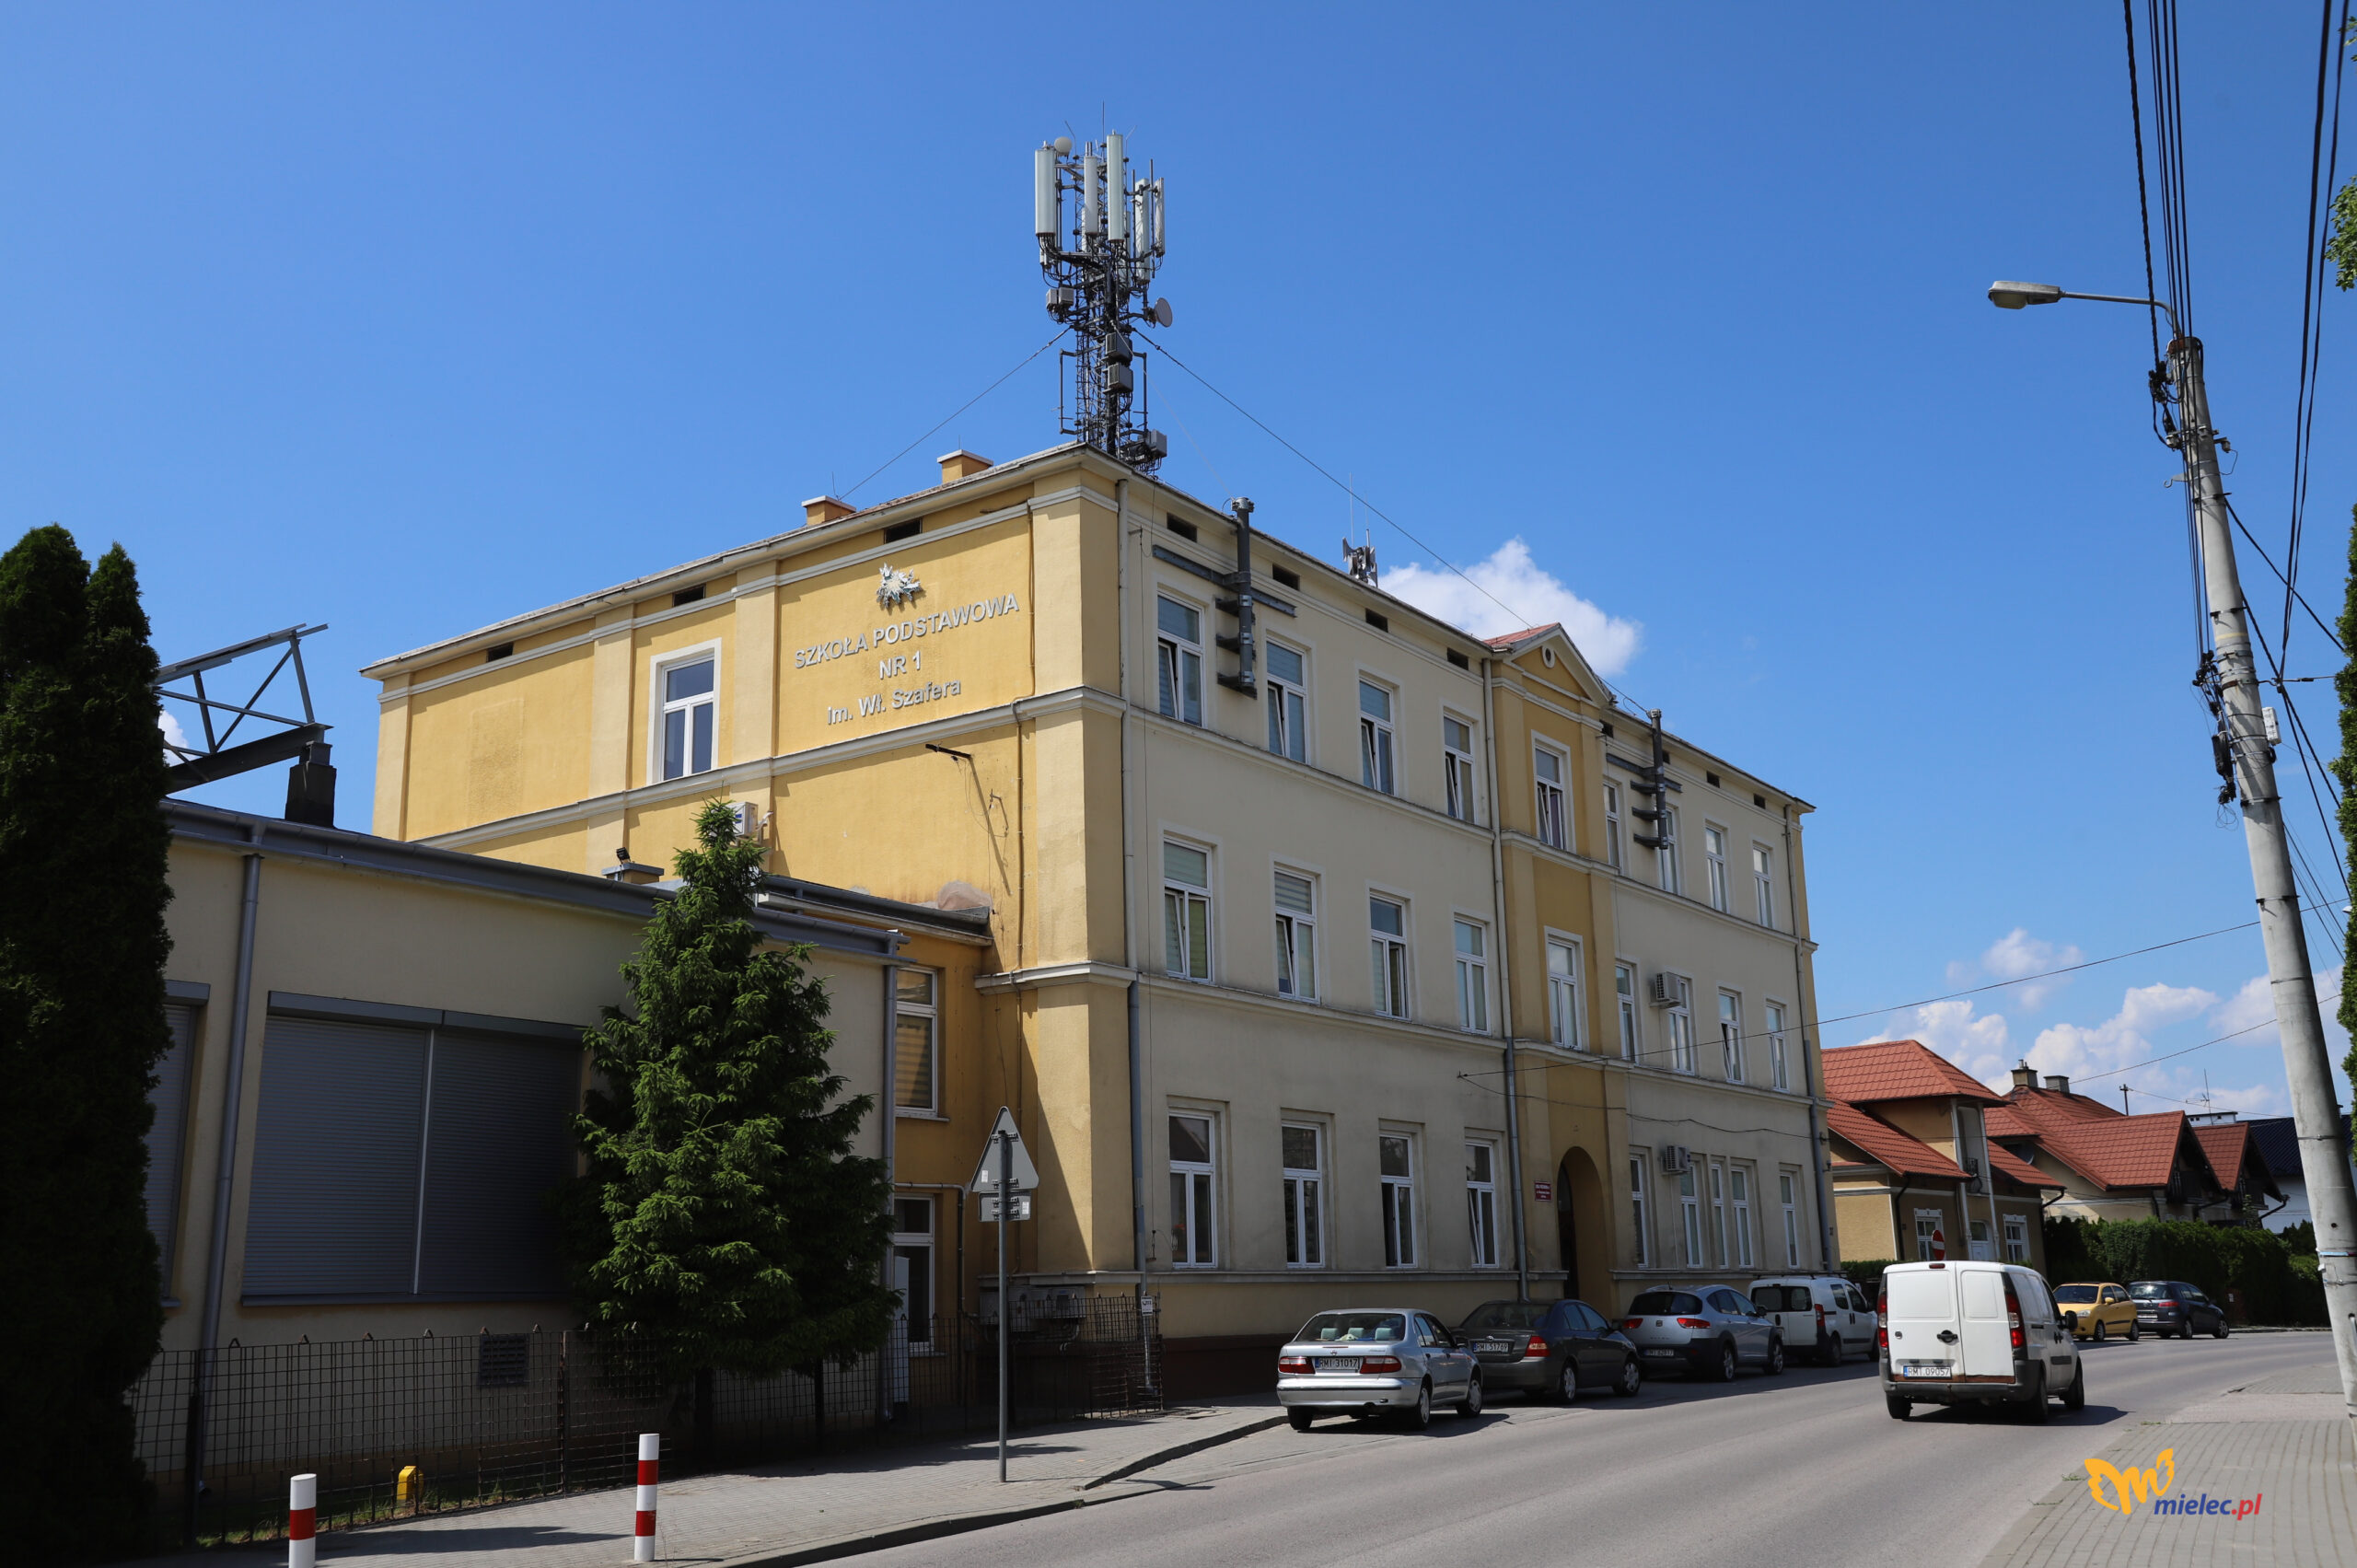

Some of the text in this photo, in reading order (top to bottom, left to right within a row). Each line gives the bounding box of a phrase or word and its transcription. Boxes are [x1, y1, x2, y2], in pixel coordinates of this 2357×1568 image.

[794, 593, 1020, 668] SZKOŁA PODSTAWOWA
[879, 650, 922, 679] NR 1
[858, 693, 887, 718] Wł.
[891, 679, 961, 710] Szafera
[1318, 1357, 1358, 1368] RMI 31017
[1925, 1367, 1950, 1376] 09057
